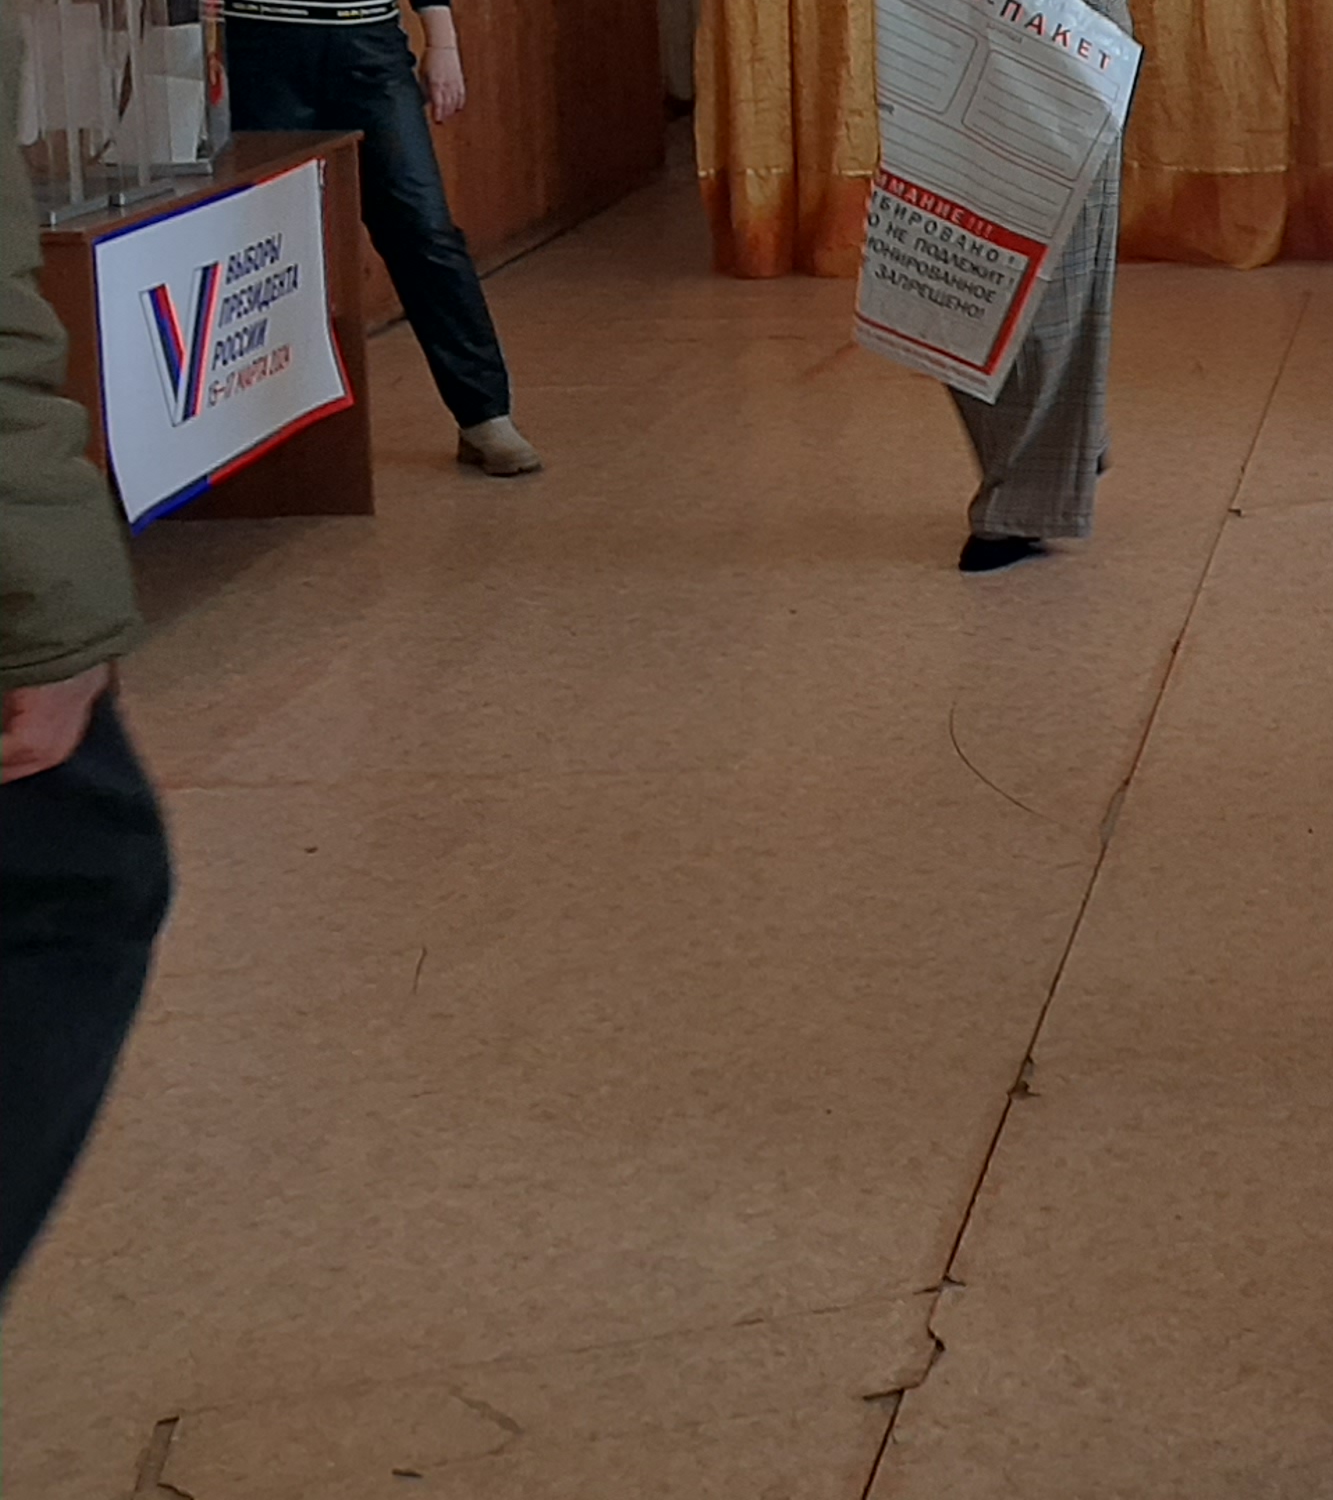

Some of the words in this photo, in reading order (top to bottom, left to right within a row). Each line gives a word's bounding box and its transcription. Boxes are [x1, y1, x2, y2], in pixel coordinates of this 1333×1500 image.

[225, 233, 282, 285] ВЫБОРЫ
[218, 263, 299, 328] ПРЕЗИДЕНТА
[211, 318, 268, 371] РОССИИ
